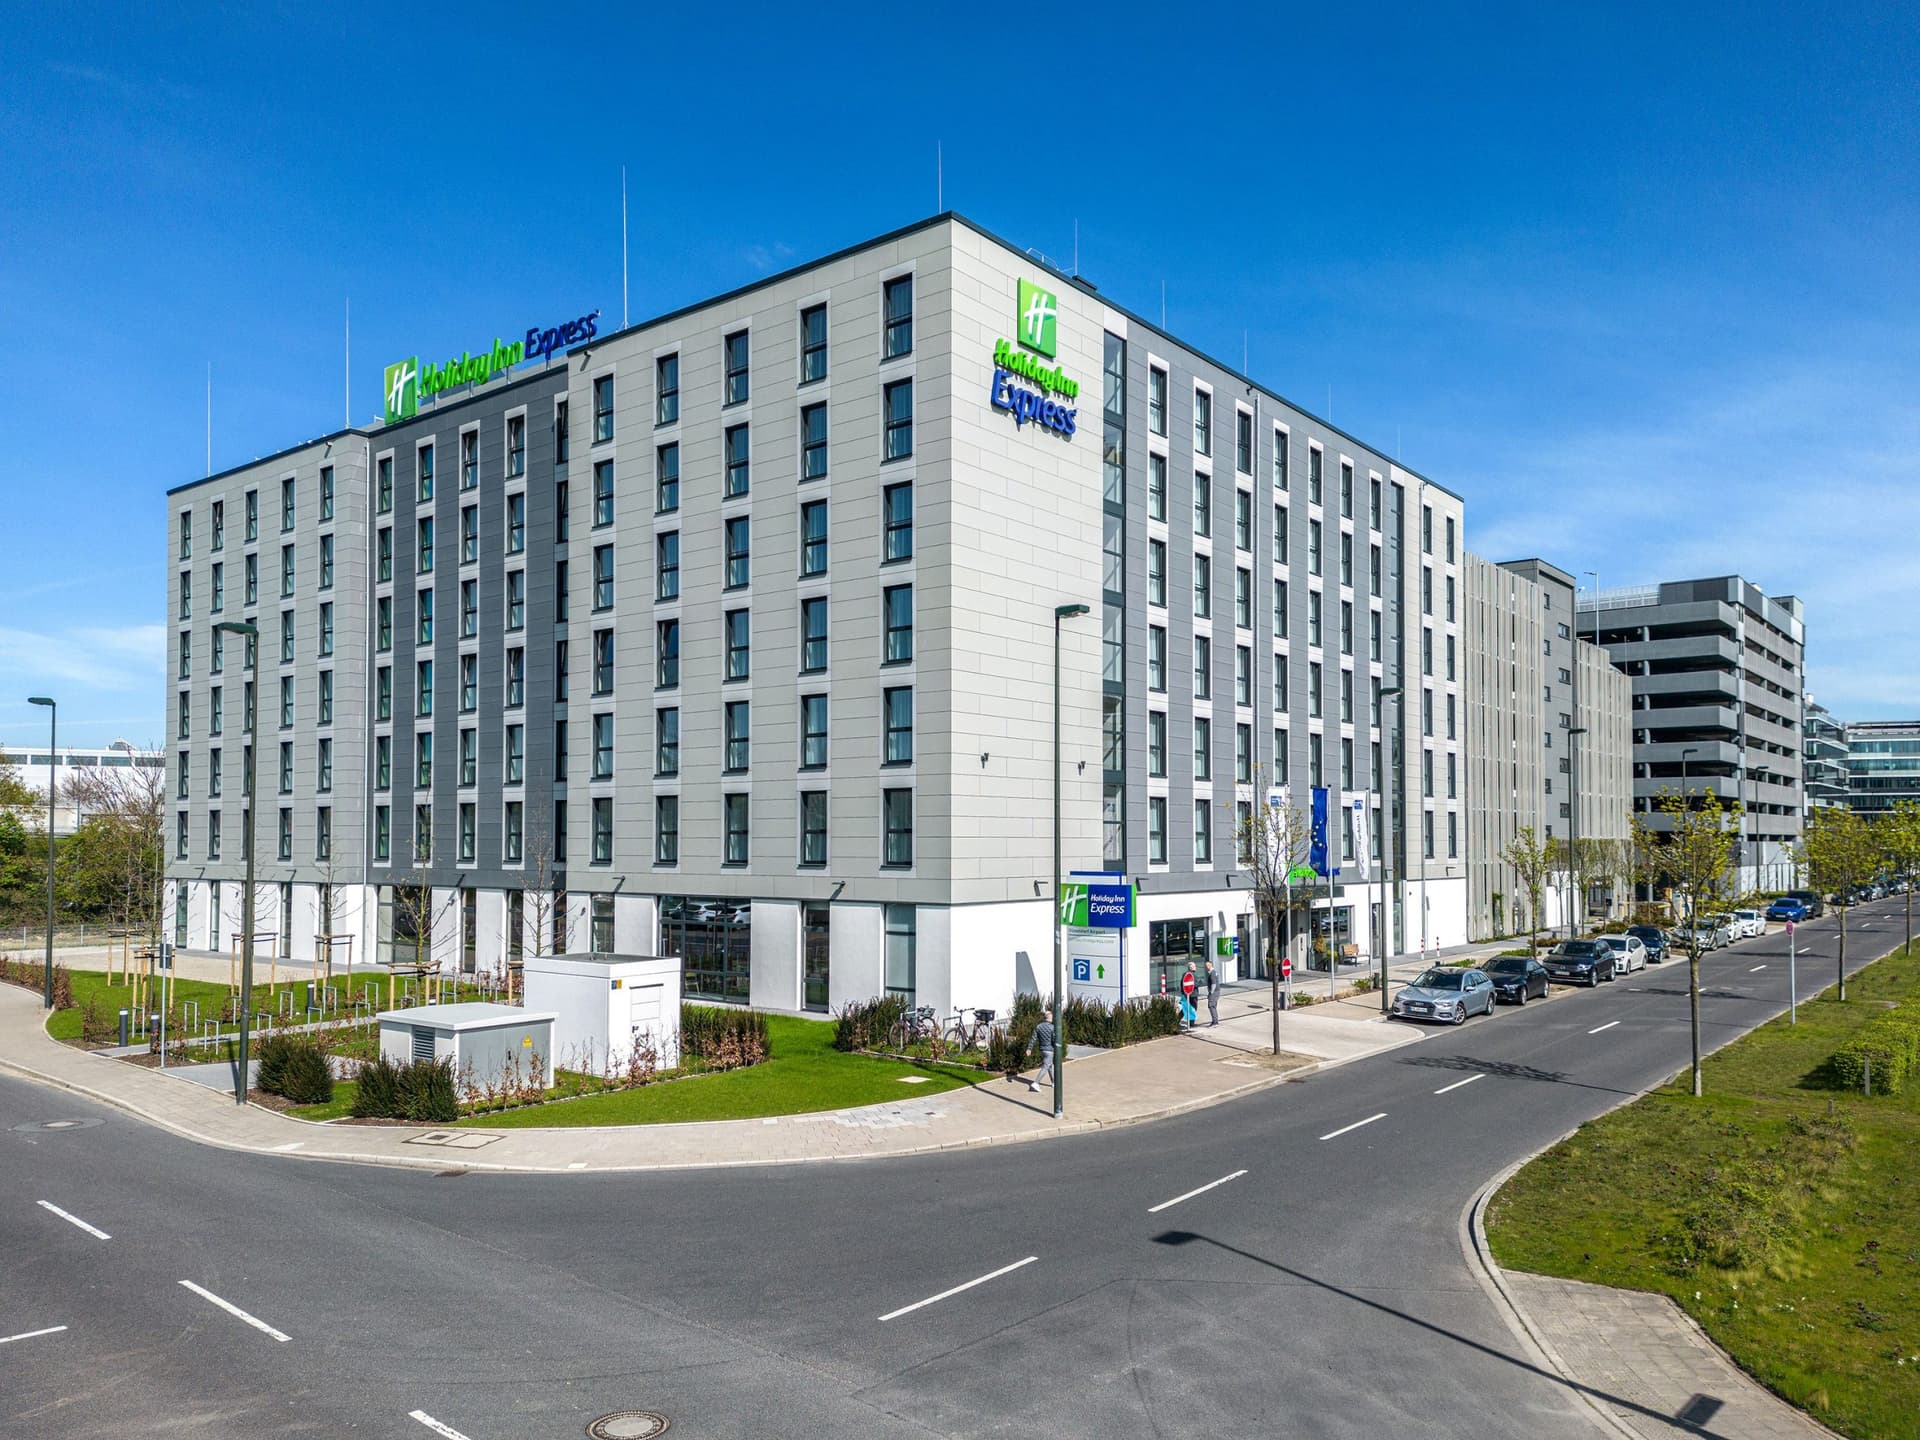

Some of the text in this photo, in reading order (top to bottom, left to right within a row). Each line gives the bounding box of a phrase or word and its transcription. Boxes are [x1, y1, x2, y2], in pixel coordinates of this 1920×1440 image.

[420, 312, 599, 398] Holiday Inn Express
[994, 338, 1079, 398] Holiday Inn
[991, 368, 1077, 435] Express
[1090, 894, 1114, 903] Holiday
[1090, 903, 1125, 915] Express
[1078, 966, 1086, 979] P
